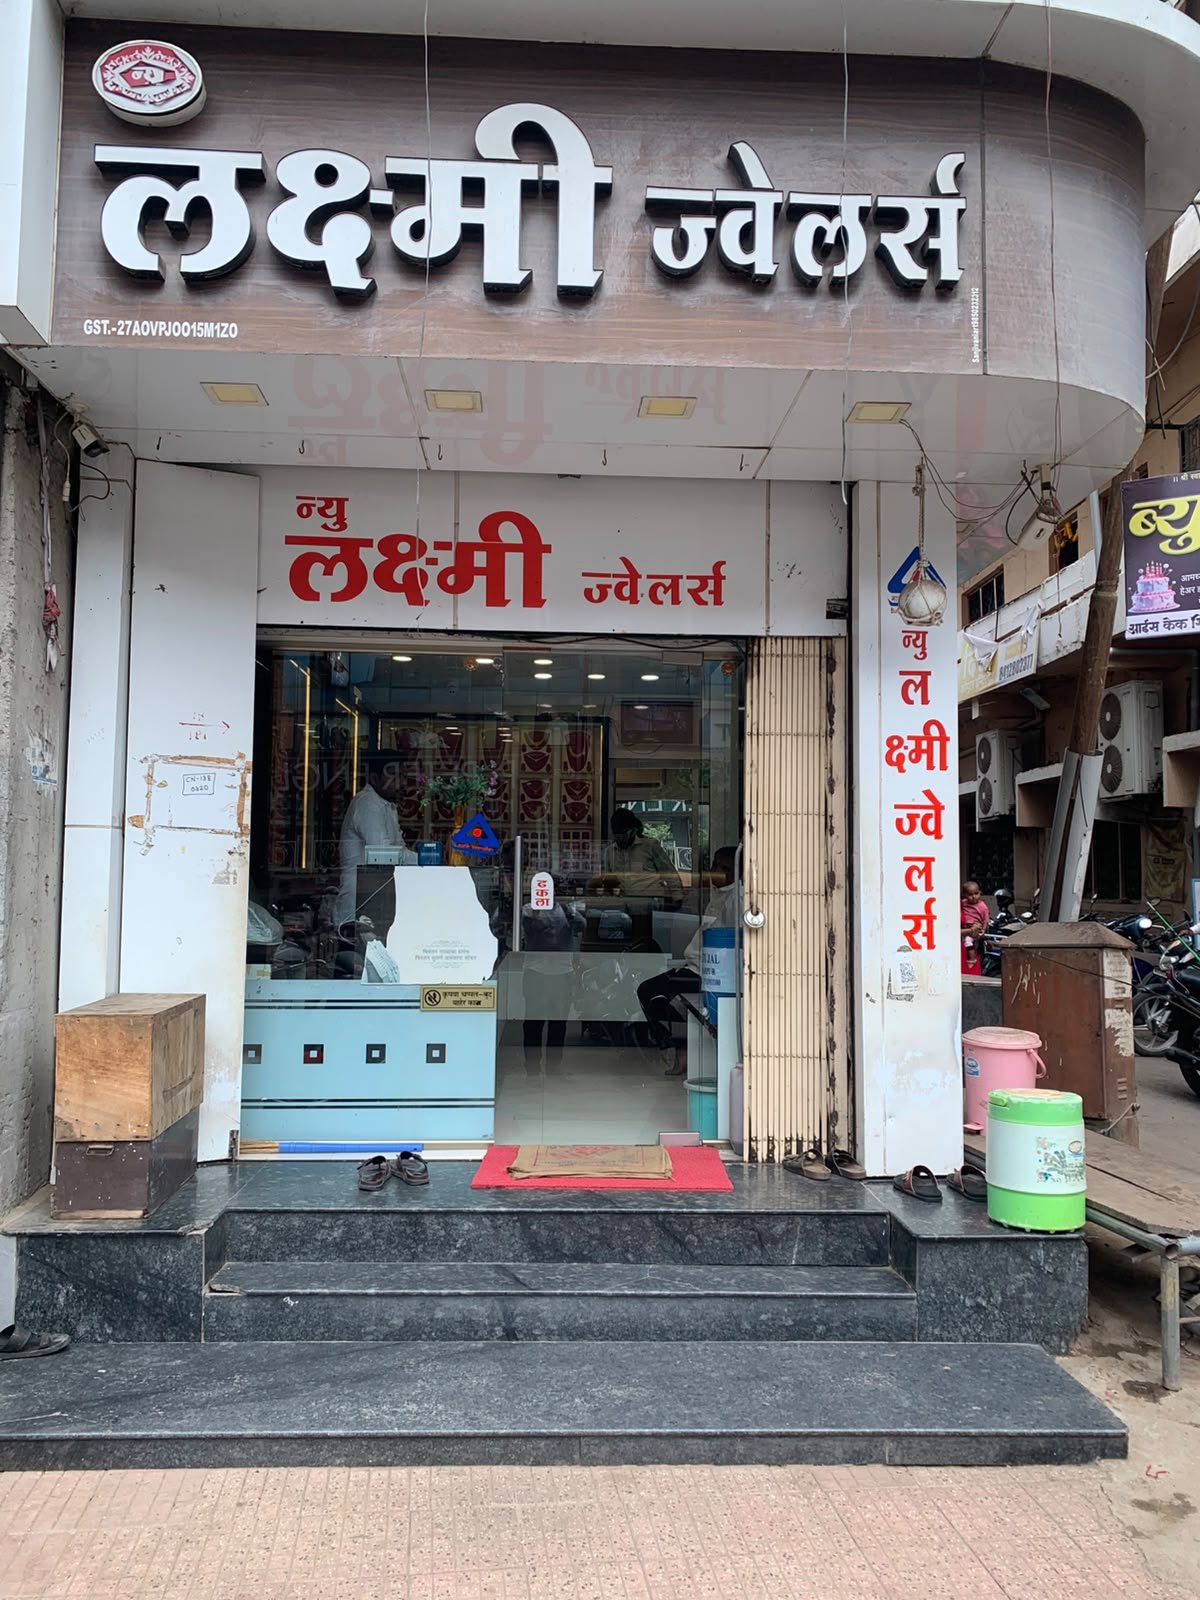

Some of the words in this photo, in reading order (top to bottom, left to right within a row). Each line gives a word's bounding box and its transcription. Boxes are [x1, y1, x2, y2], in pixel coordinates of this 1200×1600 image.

[94, 103, 613, 296] लक्ष्मी
[645, 140, 967, 290] ज्वेलर्स
[296, 496, 349, 532] न्यु
[285, 511, 552, 608] लक्ष्मी
[582, 557, 726, 606] ज्वेलर्स
[1163, 616, 1188, 631] केक
[902, 630, 928, 660] न्यु
